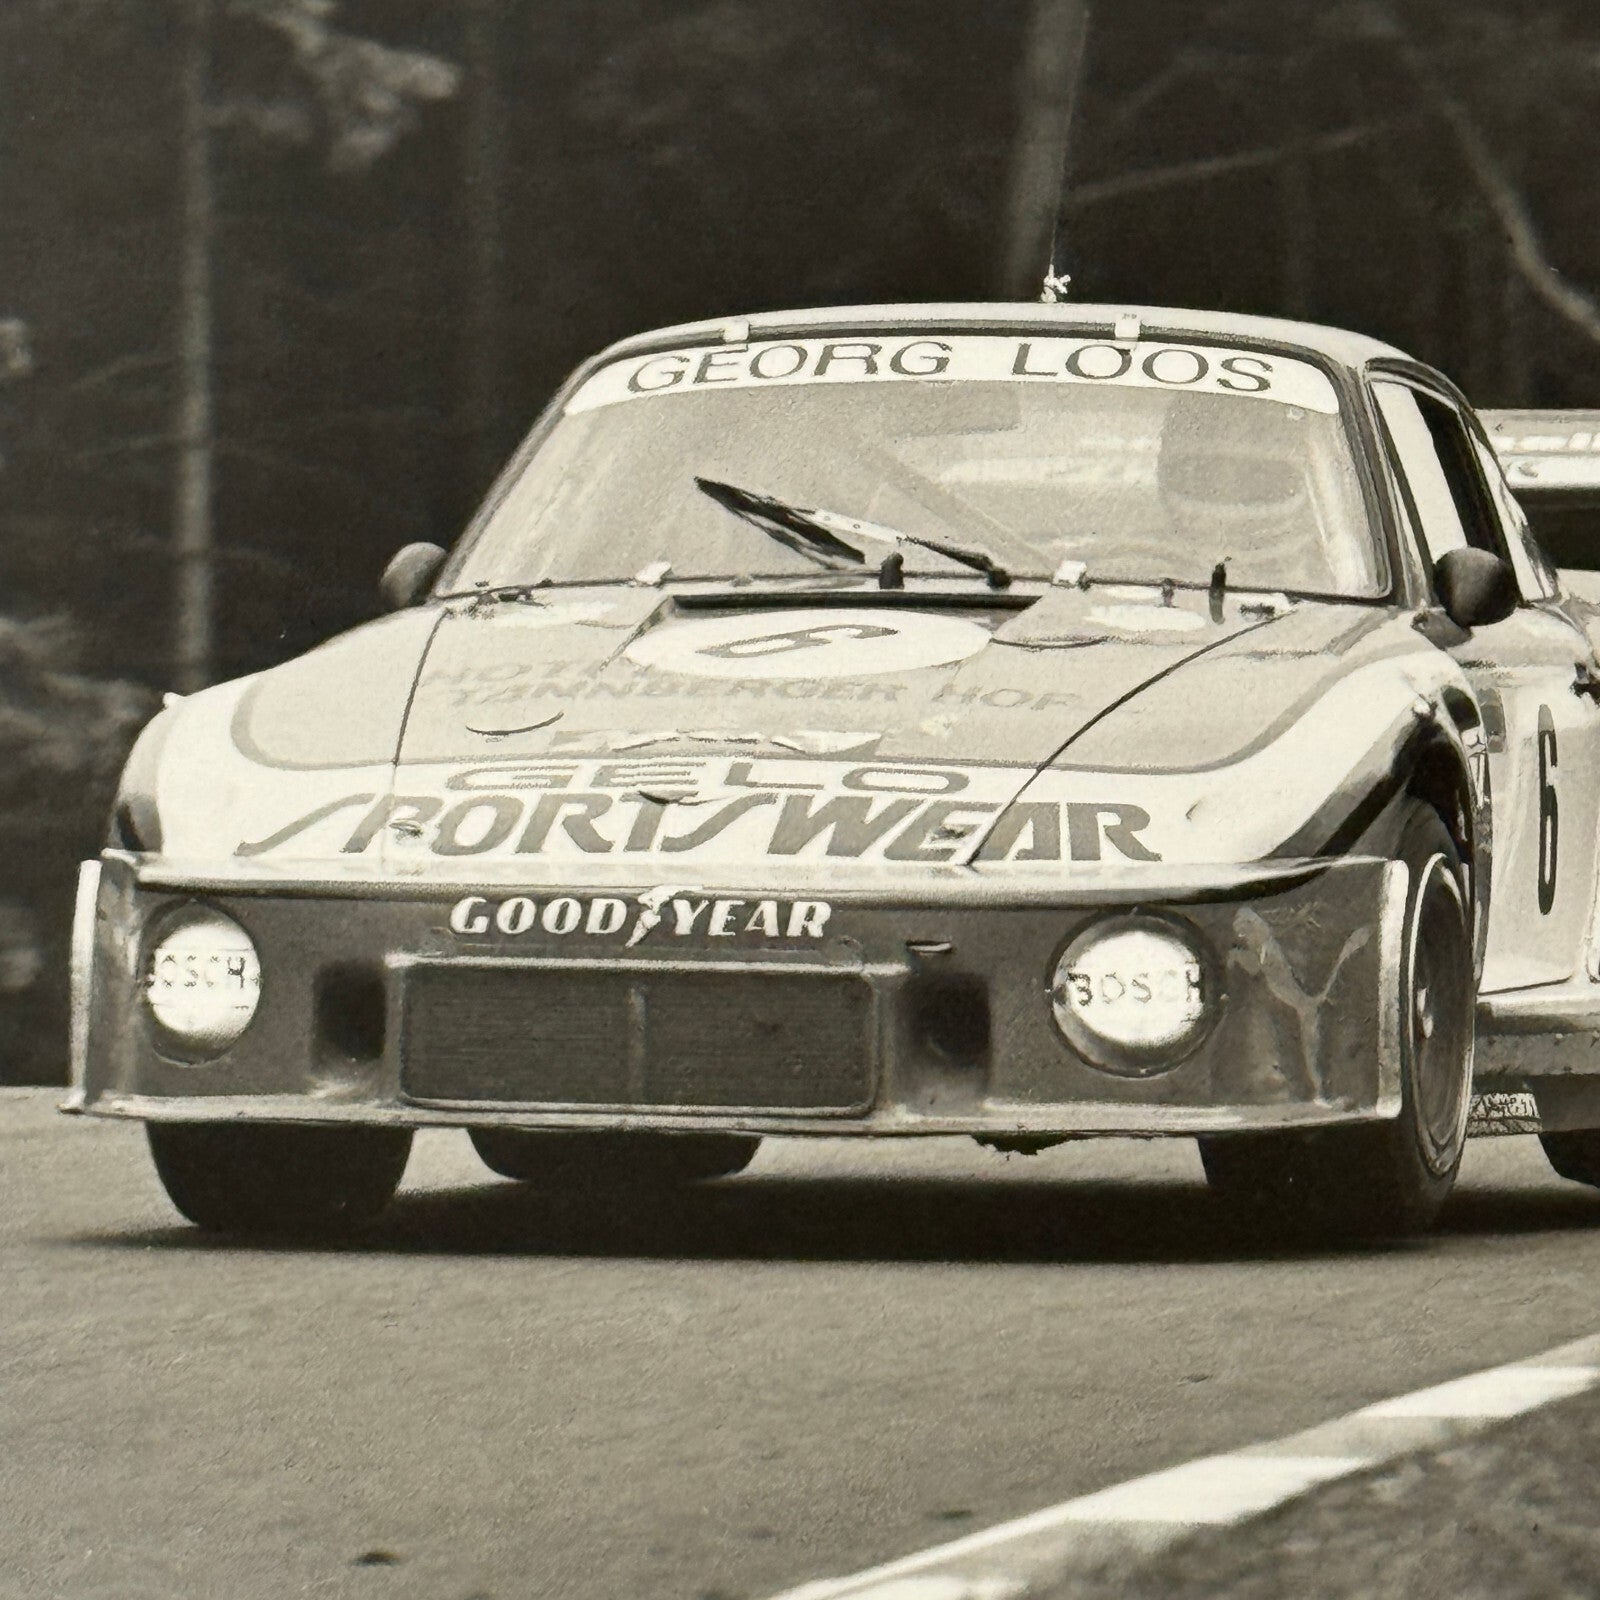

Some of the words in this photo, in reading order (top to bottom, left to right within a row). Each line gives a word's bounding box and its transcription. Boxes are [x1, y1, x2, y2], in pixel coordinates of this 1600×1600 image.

[627, 341, 952, 394] GEORG
[1011, 341, 1274, 393] LOOS
[445, 761, 970, 794] GELO
[234, 793, 1163, 862] SPORTSWEAR
[1537, 704, 1557, 915] 6
[450, 895, 832, 939] GOODYEAR
